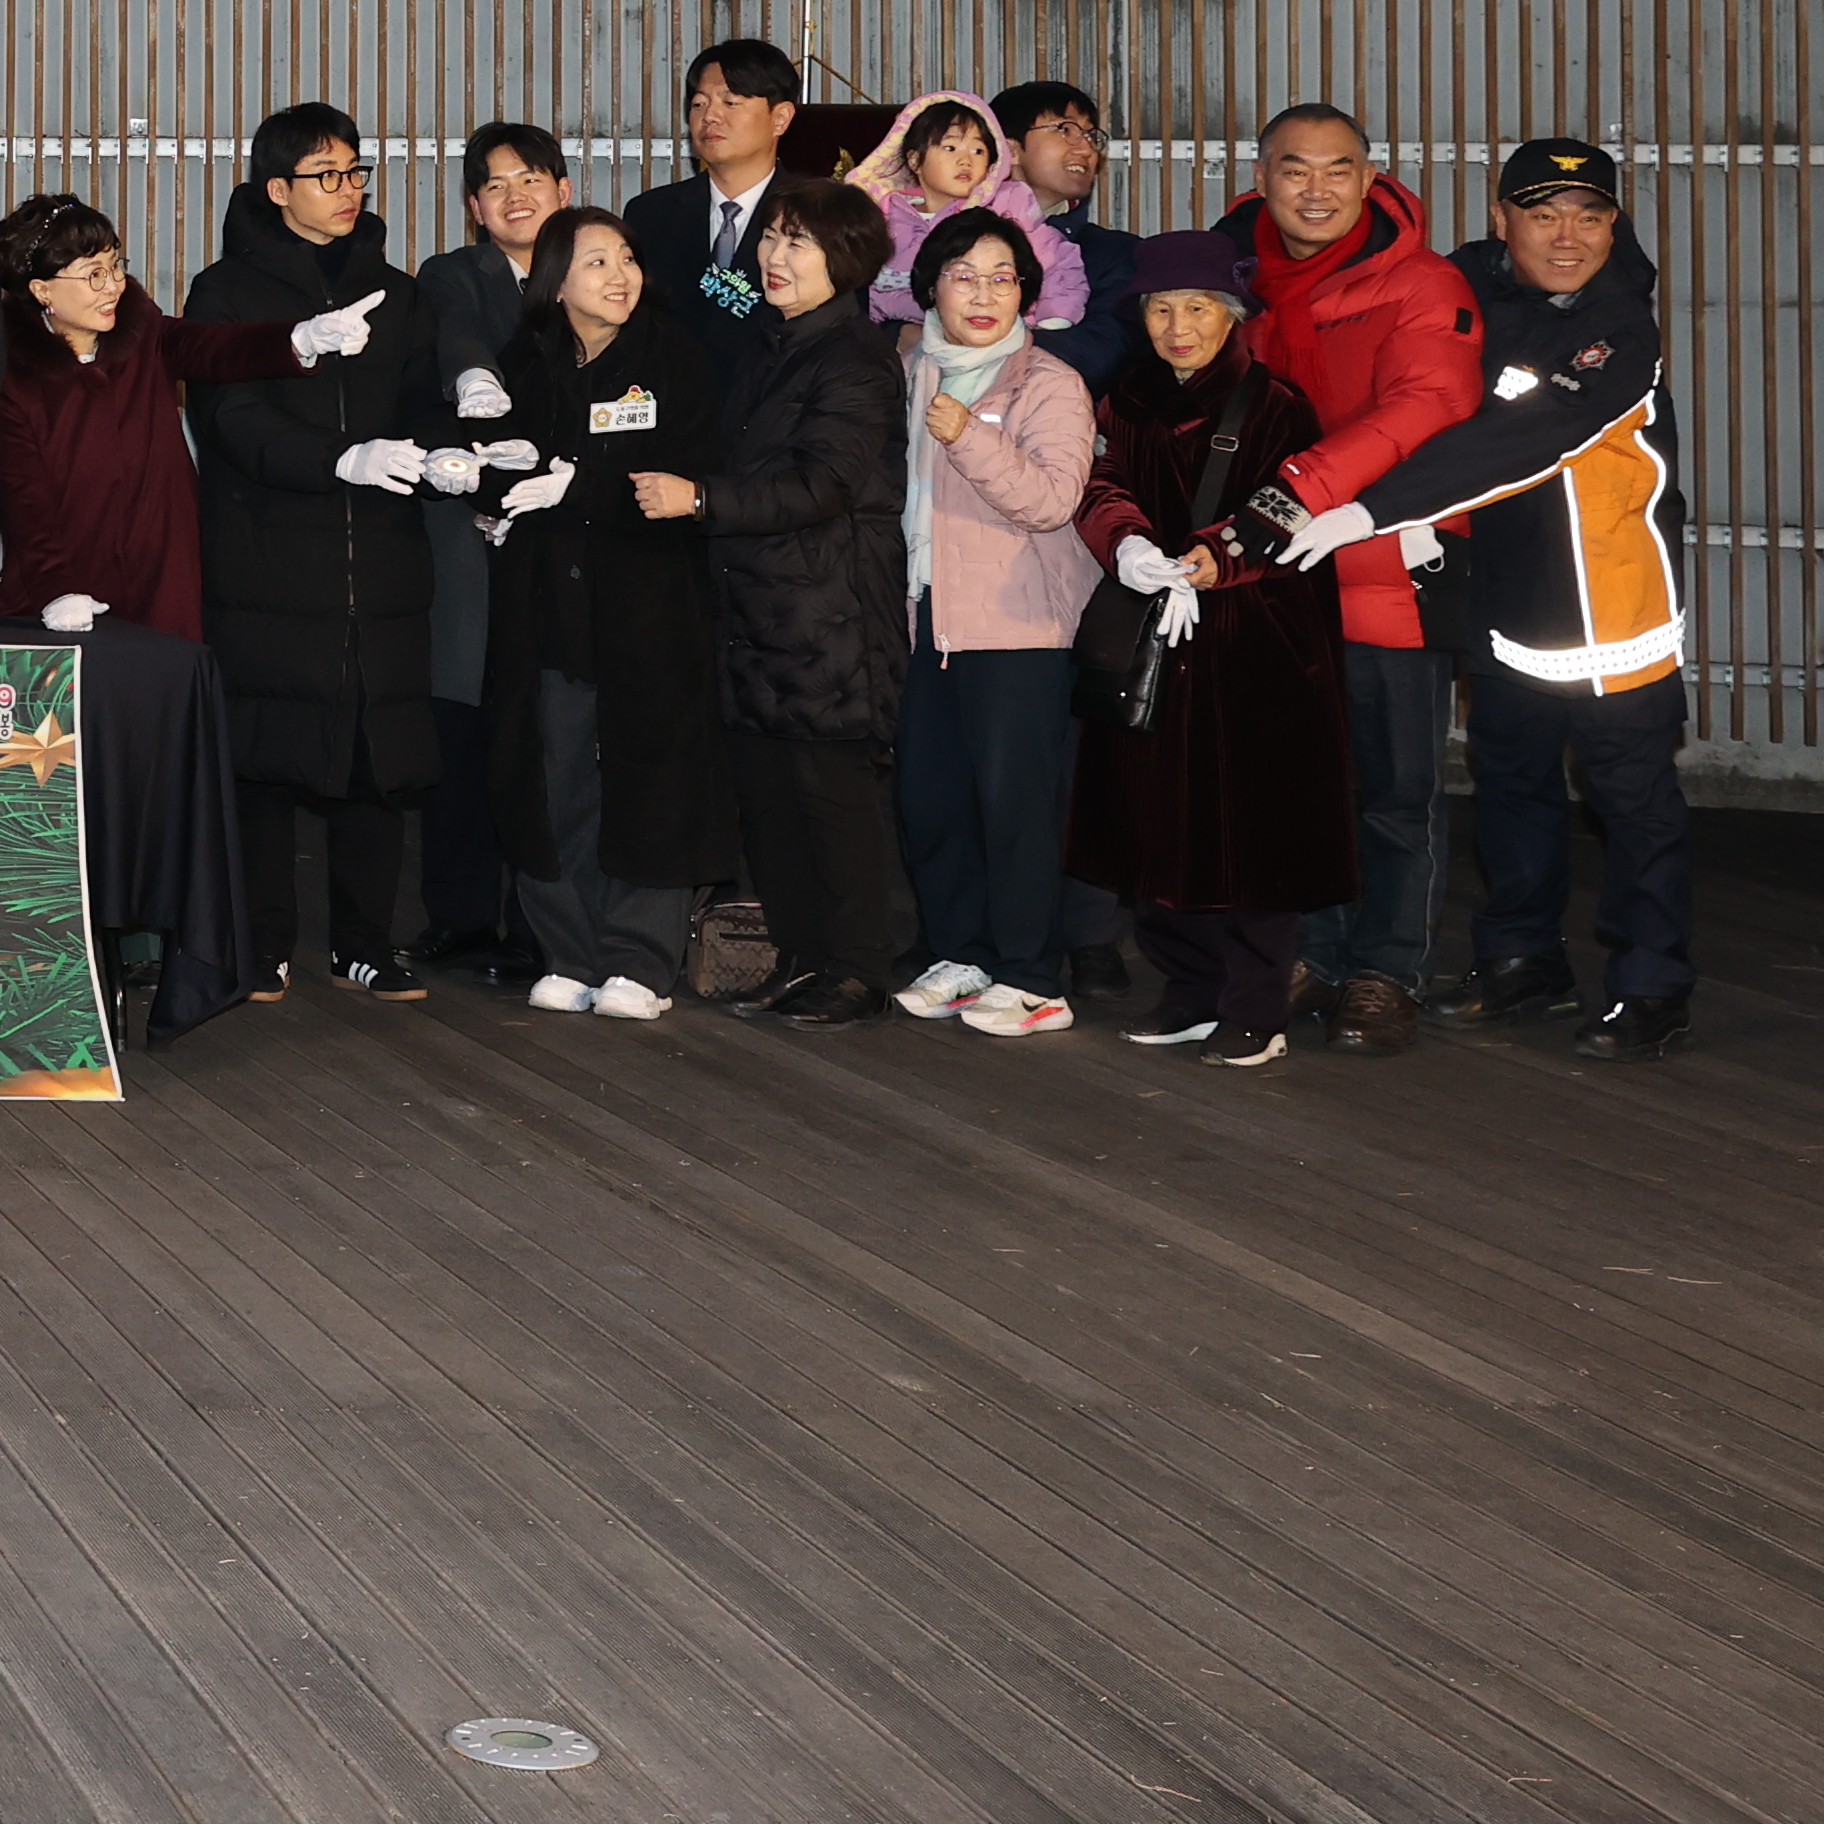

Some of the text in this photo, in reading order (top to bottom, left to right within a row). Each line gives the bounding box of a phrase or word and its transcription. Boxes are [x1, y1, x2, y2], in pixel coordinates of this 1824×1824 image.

[699, 272, 753, 318] 박상근
[719, 268, 752, 295] 구의원
[615, 411, 649, 426] 손혜영
